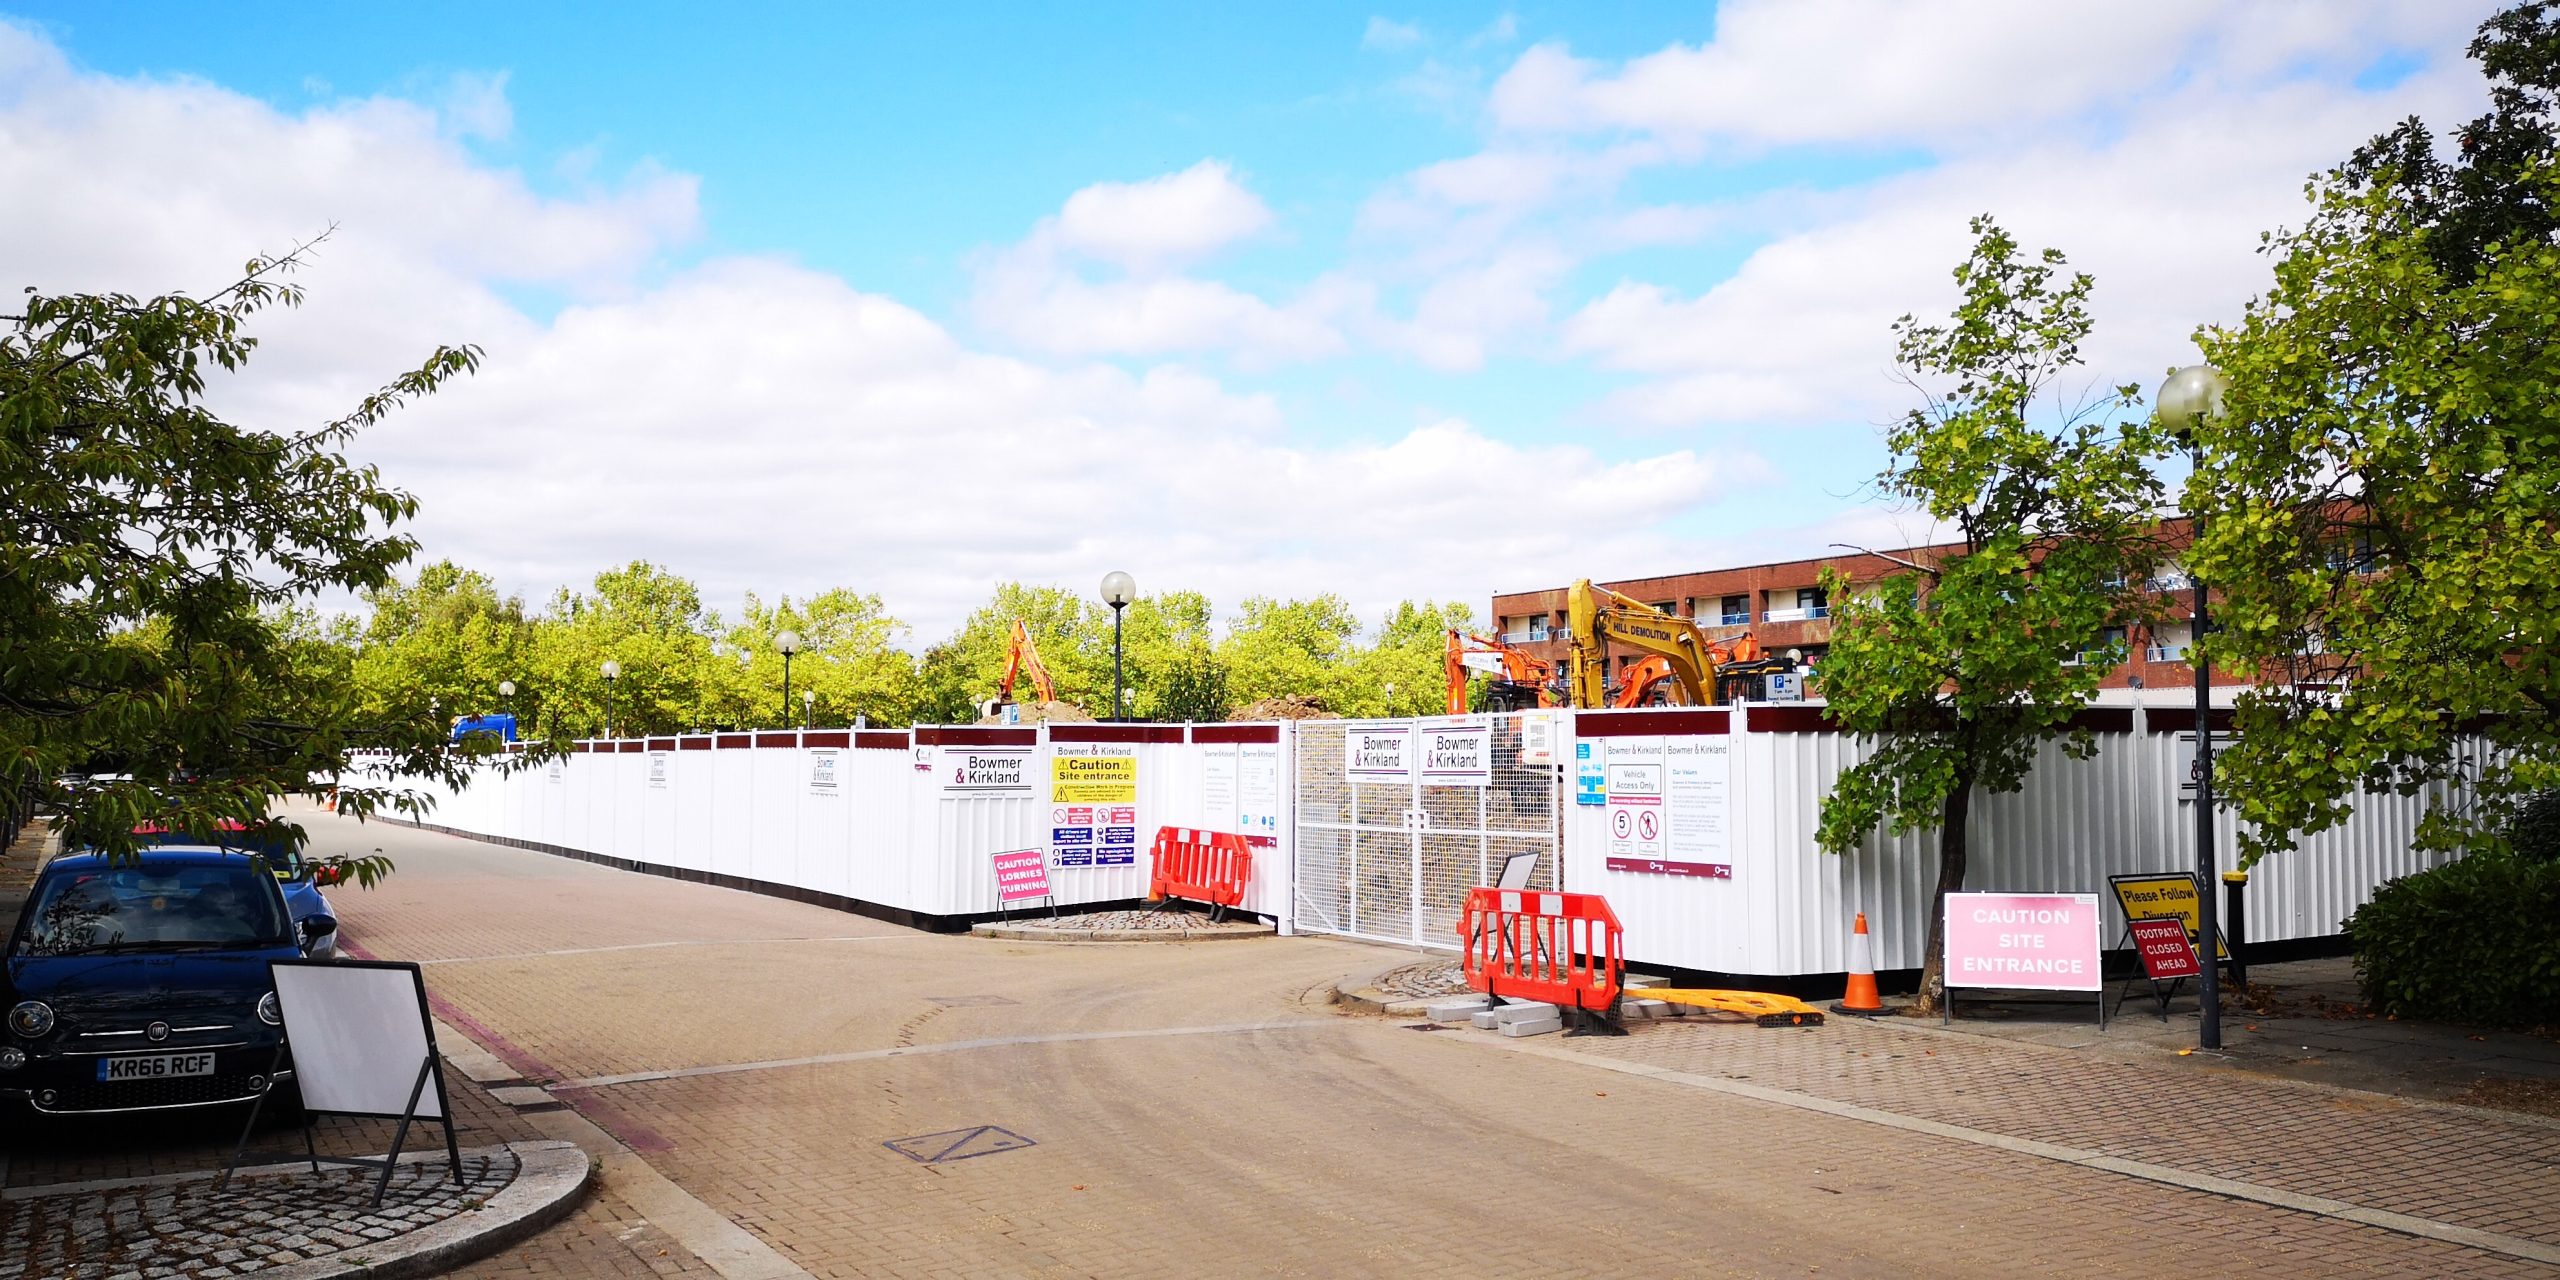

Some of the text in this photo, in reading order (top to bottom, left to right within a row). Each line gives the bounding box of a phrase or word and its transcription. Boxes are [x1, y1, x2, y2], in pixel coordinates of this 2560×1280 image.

[1614, 622, 1670, 641] HILL DEMOLITION
[1776, 676, 1783, 687] P
[1012, 706, 1018, 721] P
[1364, 736, 1401, 750] Bowmer
[1437, 735, 1478, 750] Bowmer
[1608, 744, 1662, 754] Bowmer & Kirkland
[1668, 744, 1726, 754] Bowmer & Kirkland
[1058, 744, 1131, 756] Bowmer & Kirkland
[969, 756, 1022, 768] Bowmer
[1069, 760, 1120, 770] Caution
[1355, 750, 1400, 767] & Kirkland
[1427, 750, 1477, 768] & Kirkland
[956, 768, 1020, 784] & Kirkland
[1640, 782, 1654, 791] Only
[1619, 816, 1625, 828] 5
[997, 857, 1040, 870] CAUTION
[1001, 869, 1042, 881] LORRIES
[1001, 881, 1046, 893] TURNING
[2123, 888, 2195, 903] Please Follow
[1973, 909, 2070, 924] CAUTION
[2136, 927, 2181, 940] FOOTPATH
[1999, 933, 2045, 948] SITE
[2146, 943, 2182, 954] CLOSED
[1964, 957, 2083, 973] ENTRANCE
[2156, 959, 2188, 970] AHEAD
[152, 1027, 165, 1036] FIAT
[110, 1055, 211, 1077] KR66 RCF
